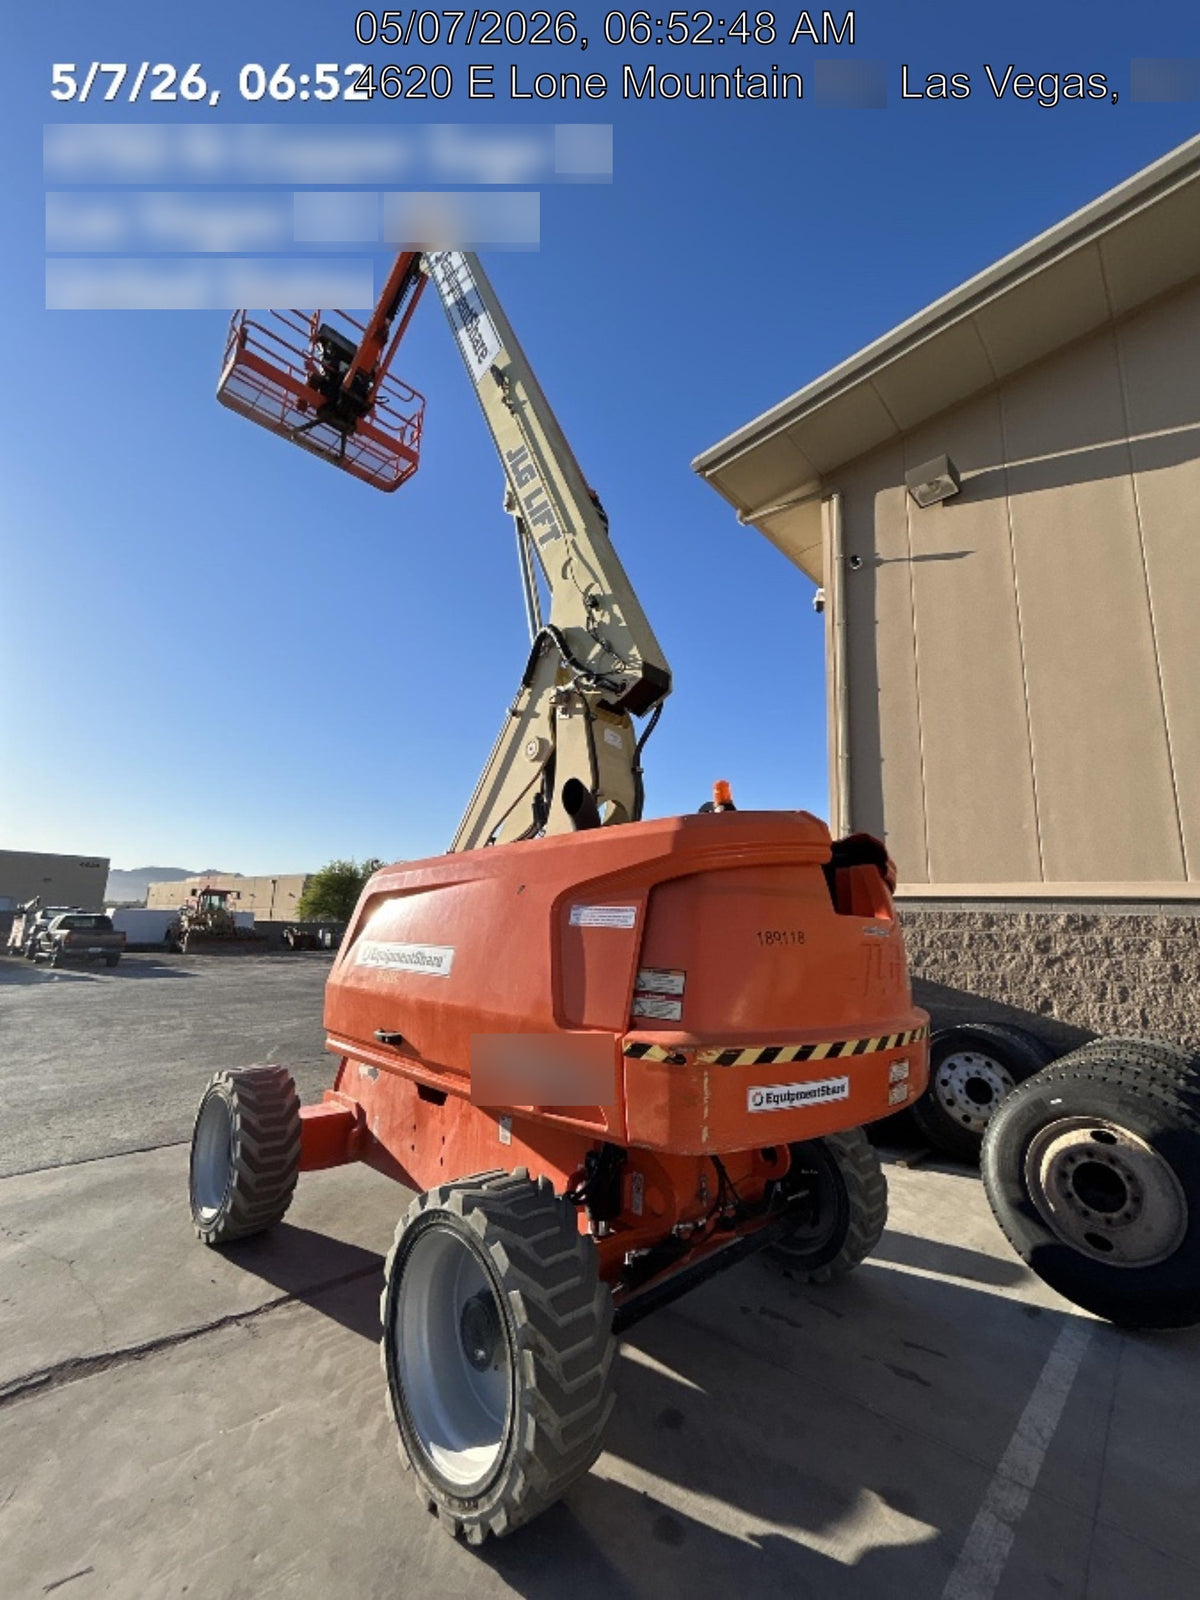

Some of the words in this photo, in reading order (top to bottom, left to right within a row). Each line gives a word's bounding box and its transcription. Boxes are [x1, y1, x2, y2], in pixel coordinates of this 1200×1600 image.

[505, 444, 538, 490] JLG
[523, 486, 563, 547] LIFT
[756, 930, 805, 946] 189118
[765, 1084, 846, 1105] EquipmentShare
